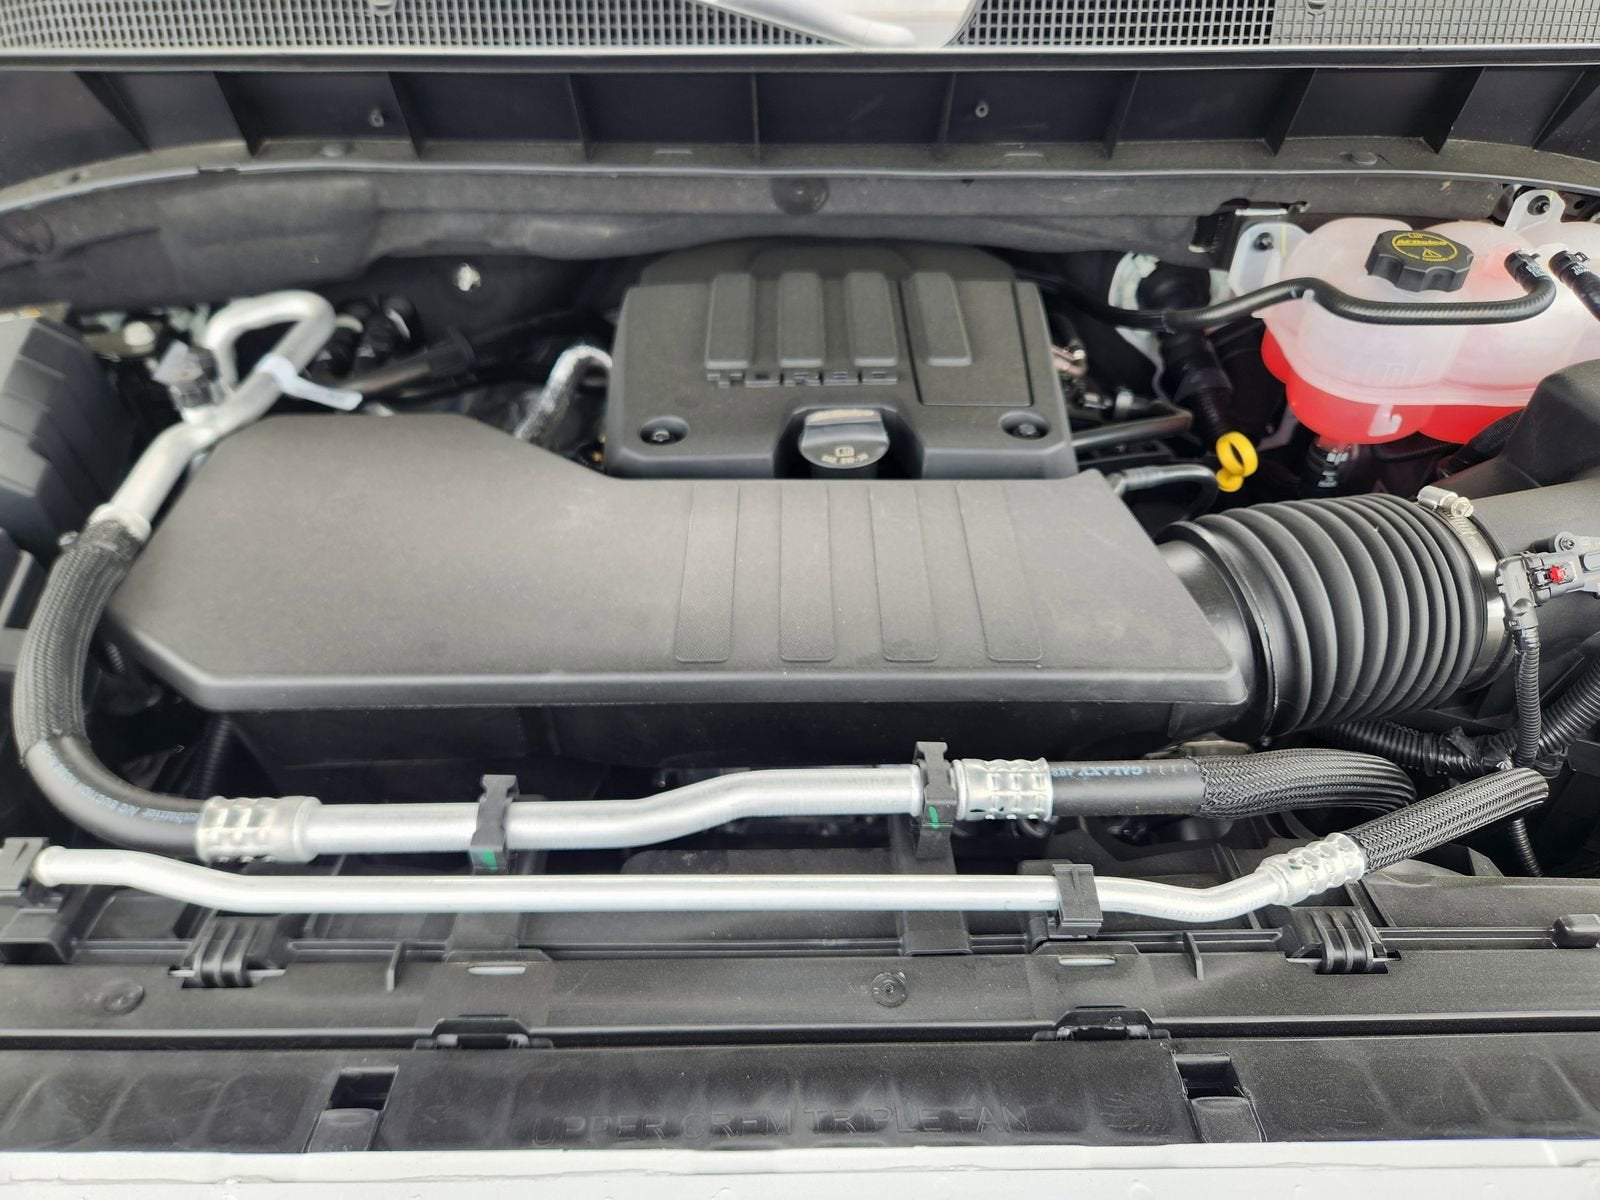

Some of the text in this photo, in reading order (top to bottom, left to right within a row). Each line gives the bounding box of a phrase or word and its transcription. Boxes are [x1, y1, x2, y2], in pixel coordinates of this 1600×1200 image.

[1078, 765, 1143, 777] GALAXY
[532, 1114, 667, 1146] UPPER
[804, 1106, 943, 1134] TRIPLE
[959, 1104, 1032, 1134] FAN
